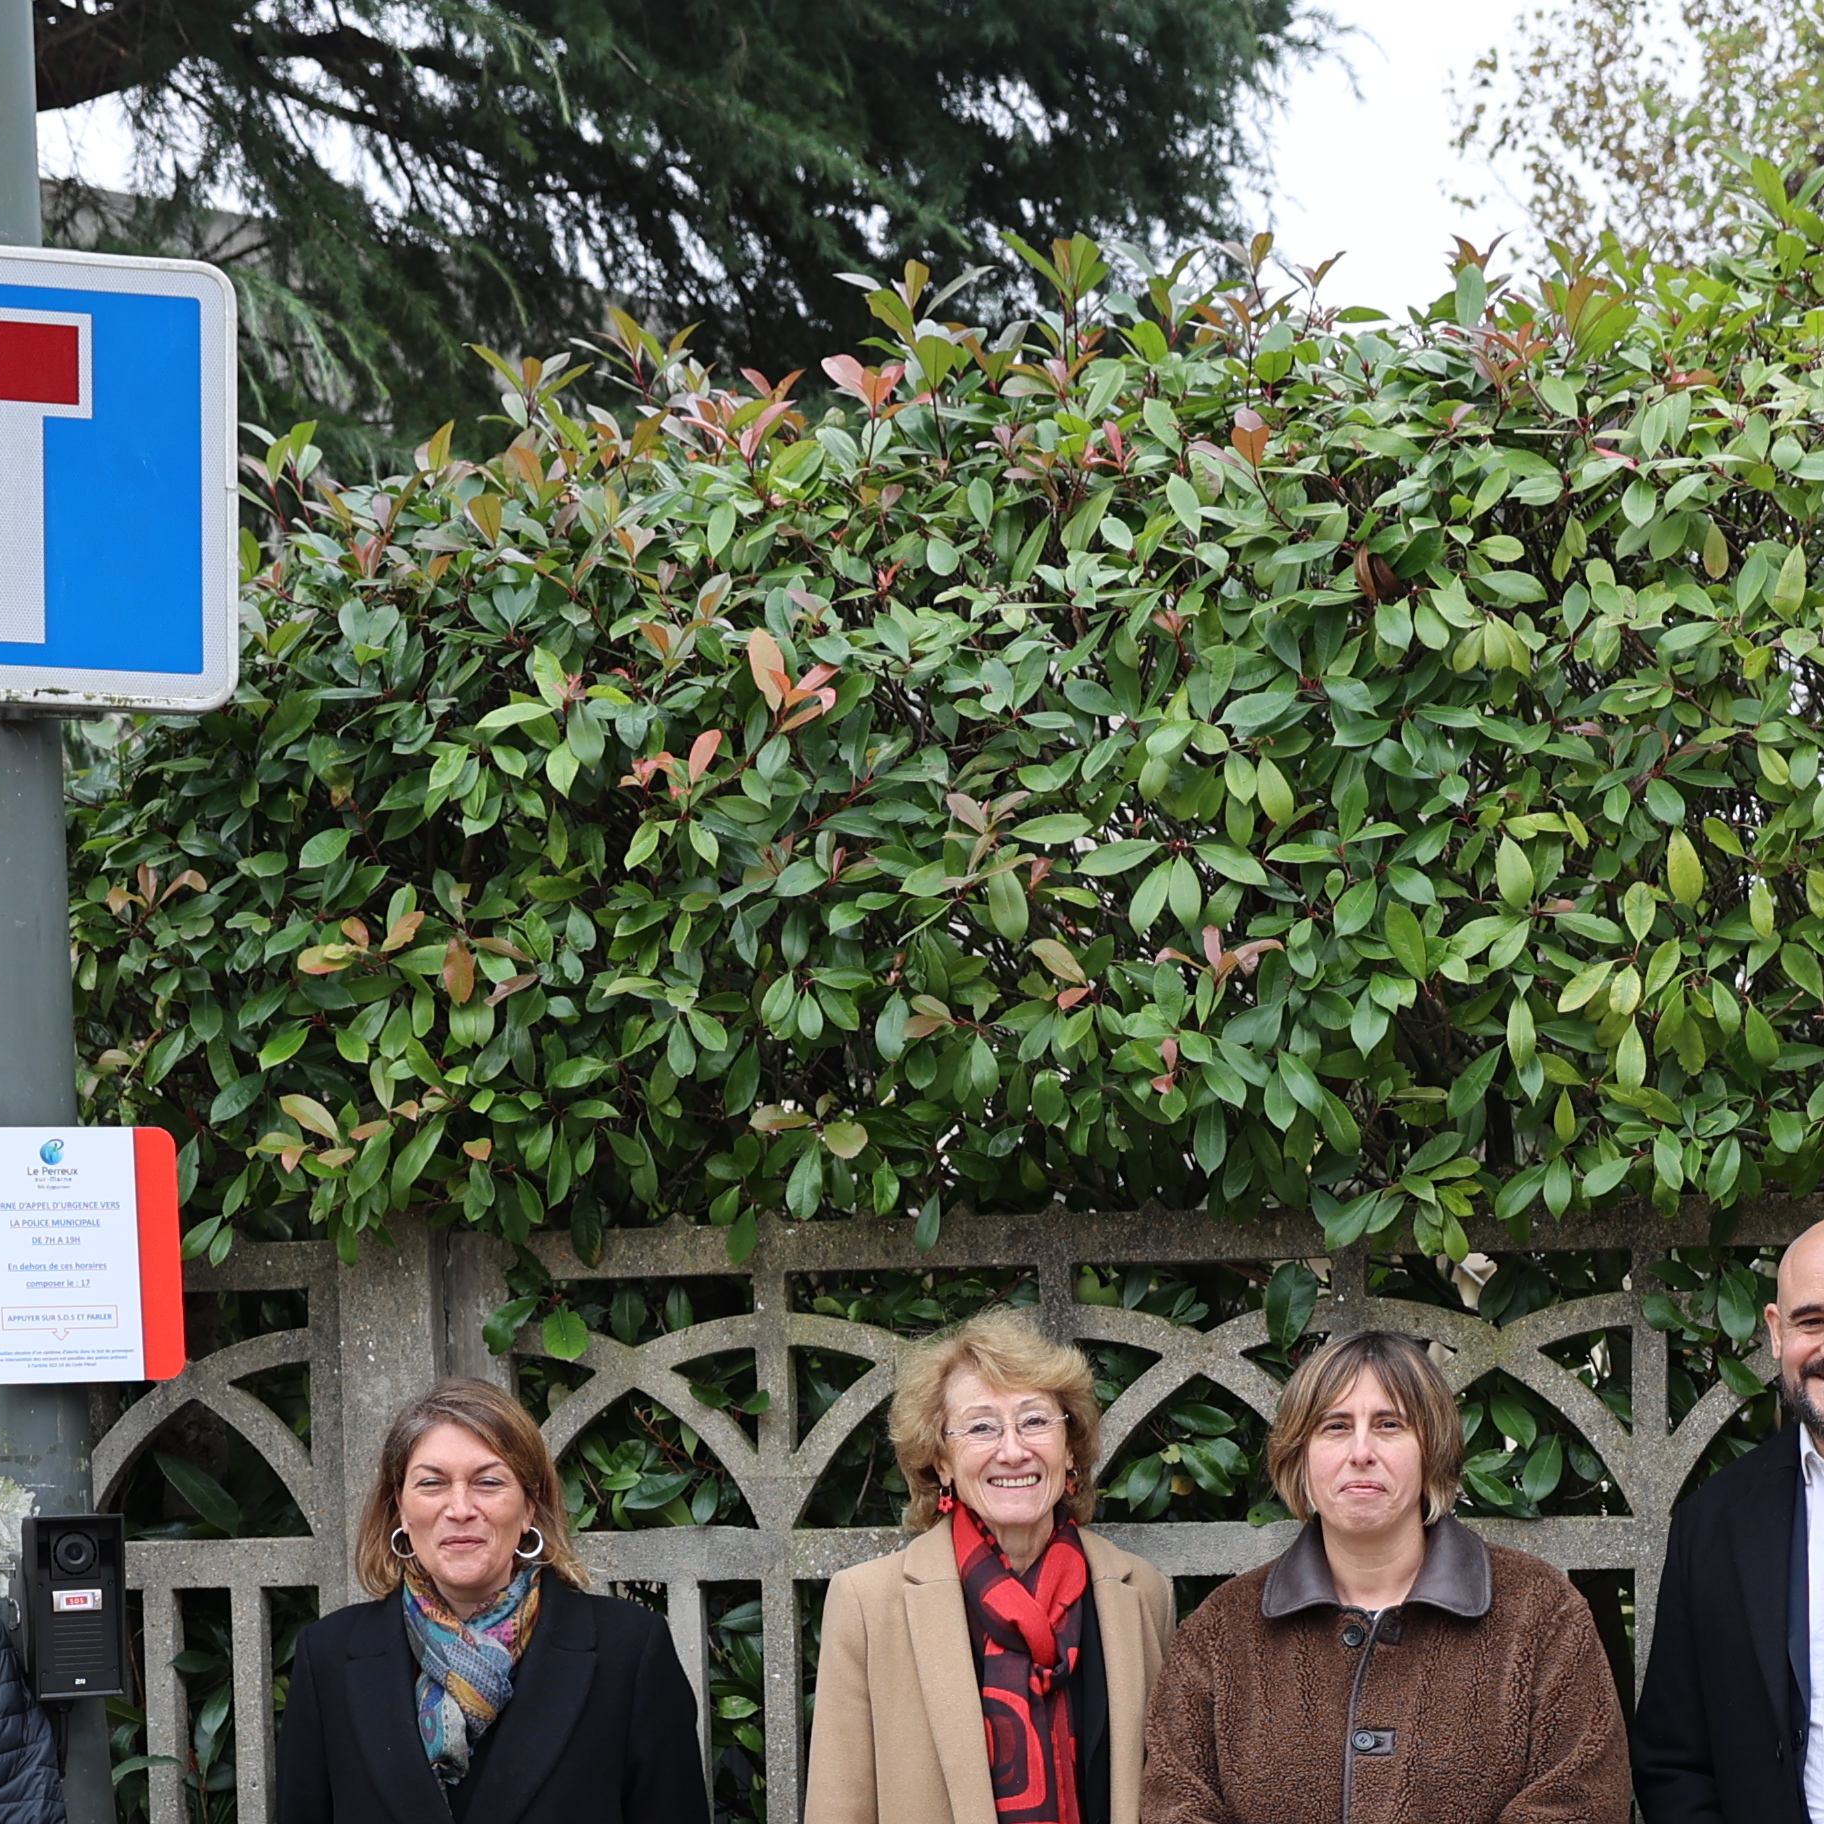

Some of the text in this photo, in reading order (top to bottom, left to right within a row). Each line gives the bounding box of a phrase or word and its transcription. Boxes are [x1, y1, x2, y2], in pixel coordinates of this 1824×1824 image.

[27, 1166, 78, 1176] Le Perreux
[19, 1202, 50, 1210] D'APPEL
[53, 1201, 98, 1209] D'URGENCE
[101, 1201, 120, 1209] VERS
[9, 1219, 101, 1227] LA POLICE MUNICIPALE
[31, 1236, 81, 1244] DE 7H A 19H
[7, 1263, 18, 1271] En
[19, 1262, 47, 1270] dehors
[48, 1262, 59, 1270] de
[26, 1280, 65, 1288] composer
[66, 1279, 74, 1287] le
[80, 1279, 91, 1287] 17
[41, 1314, 56, 1322] SUR
[69, 1597, 85, 1605] SOS
